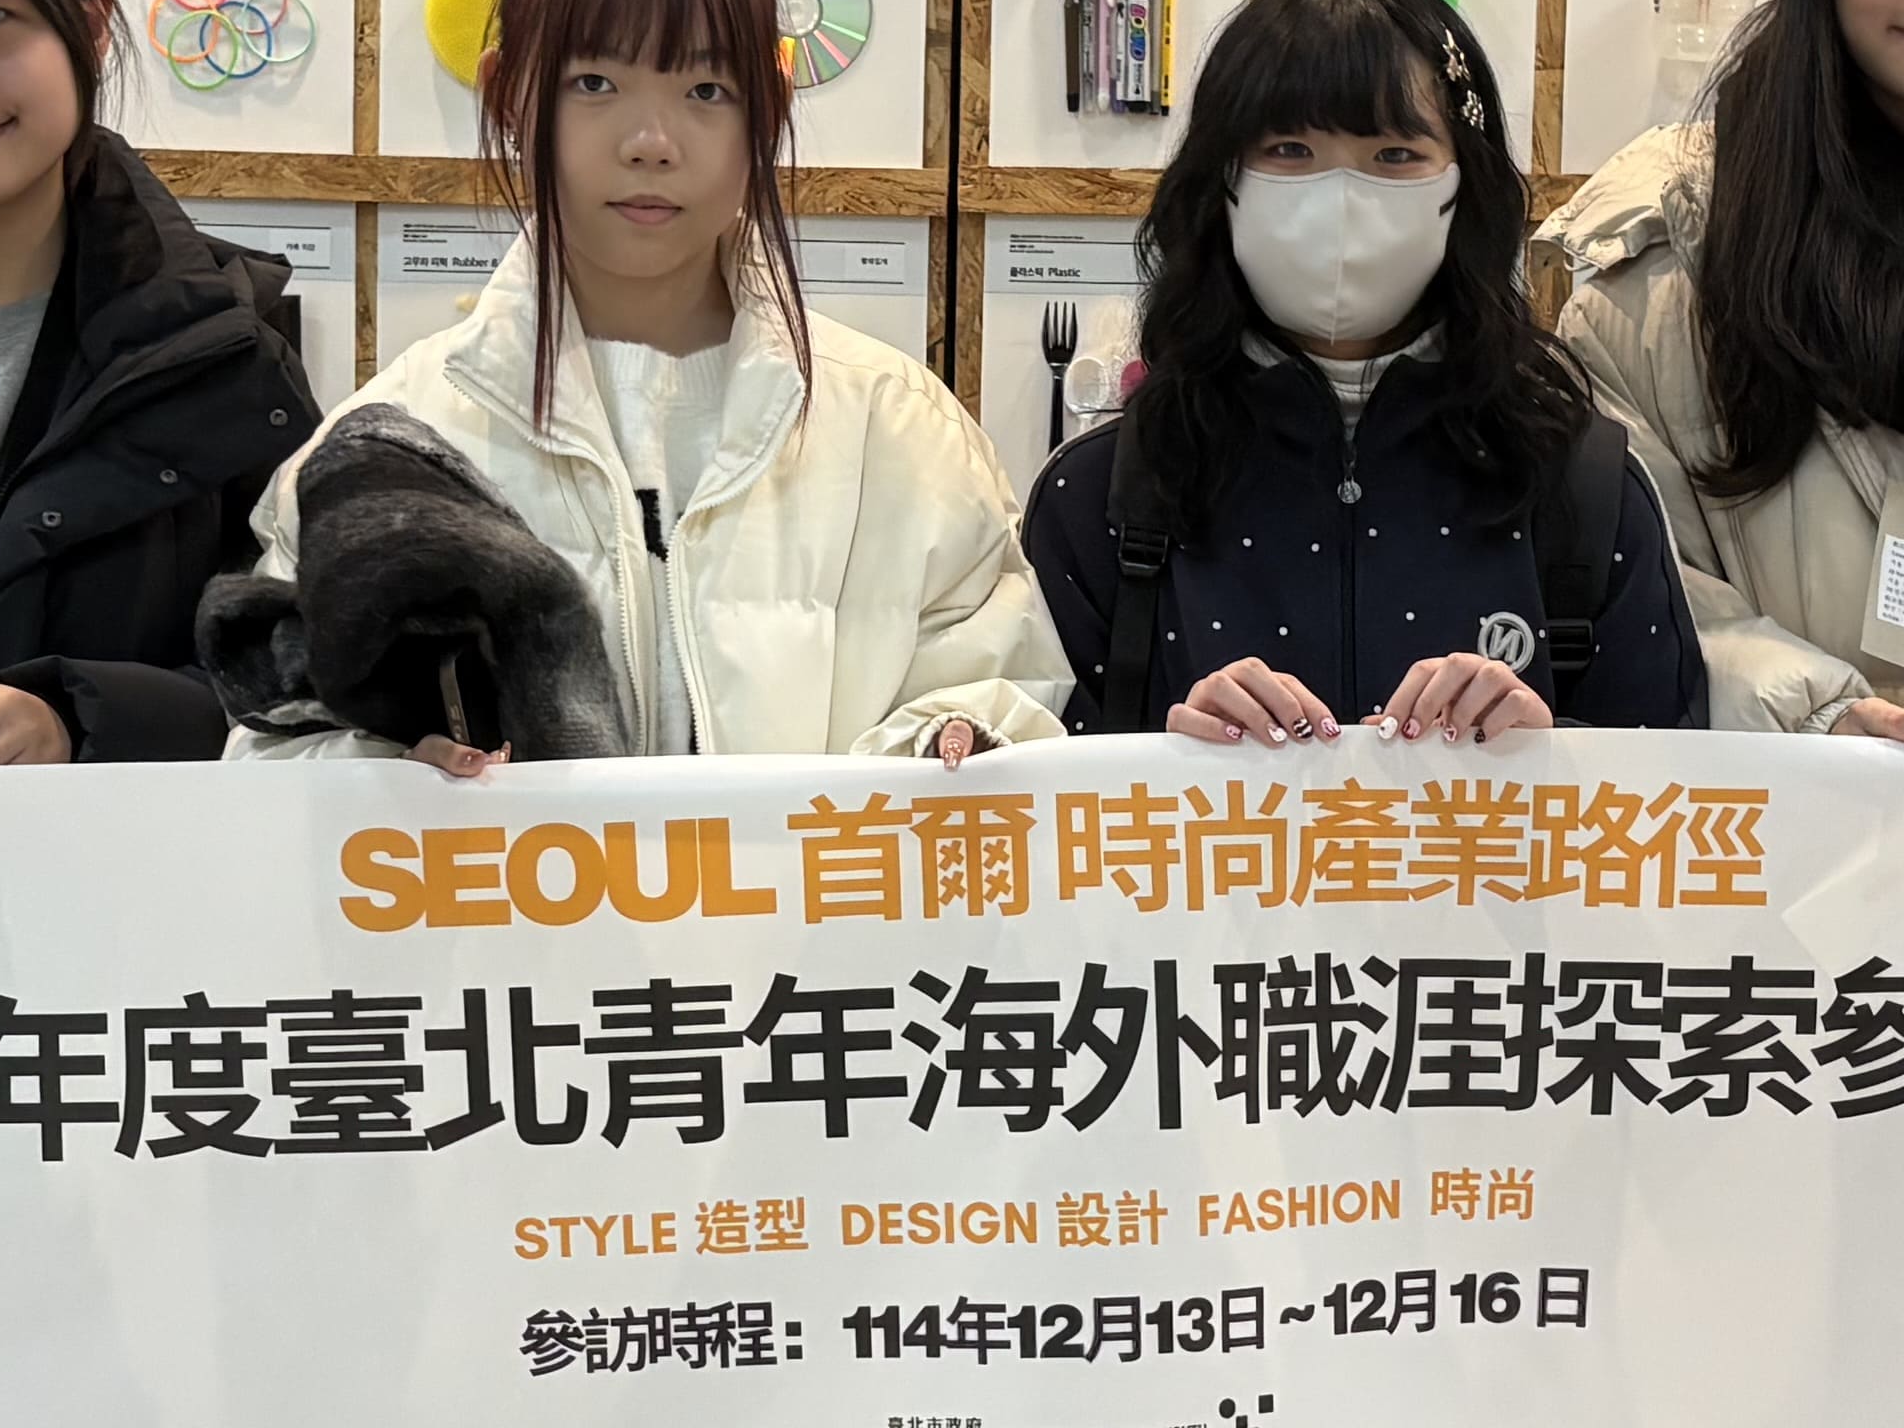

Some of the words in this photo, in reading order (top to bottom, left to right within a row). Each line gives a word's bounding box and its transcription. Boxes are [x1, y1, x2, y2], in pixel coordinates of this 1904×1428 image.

[452, 257, 488, 267] Rubber
[1048, 268, 1080, 277] Plastic
[341, 818, 777, 932] SEOUL
[788, 793, 1036, 924] 首爾
[1056, 779, 1769, 912] 時尚產業路徑
[516, 1213, 676, 1259] STYLE
[696, 1198, 808, 1254] 造型
[842, 1203, 1037, 1245] DESIGN
[1057, 1191, 1168, 1247] 設計
[1200, 1180, 1400, 1236] FASHION
[1432, 1168, 1533, 1220] 時尚
